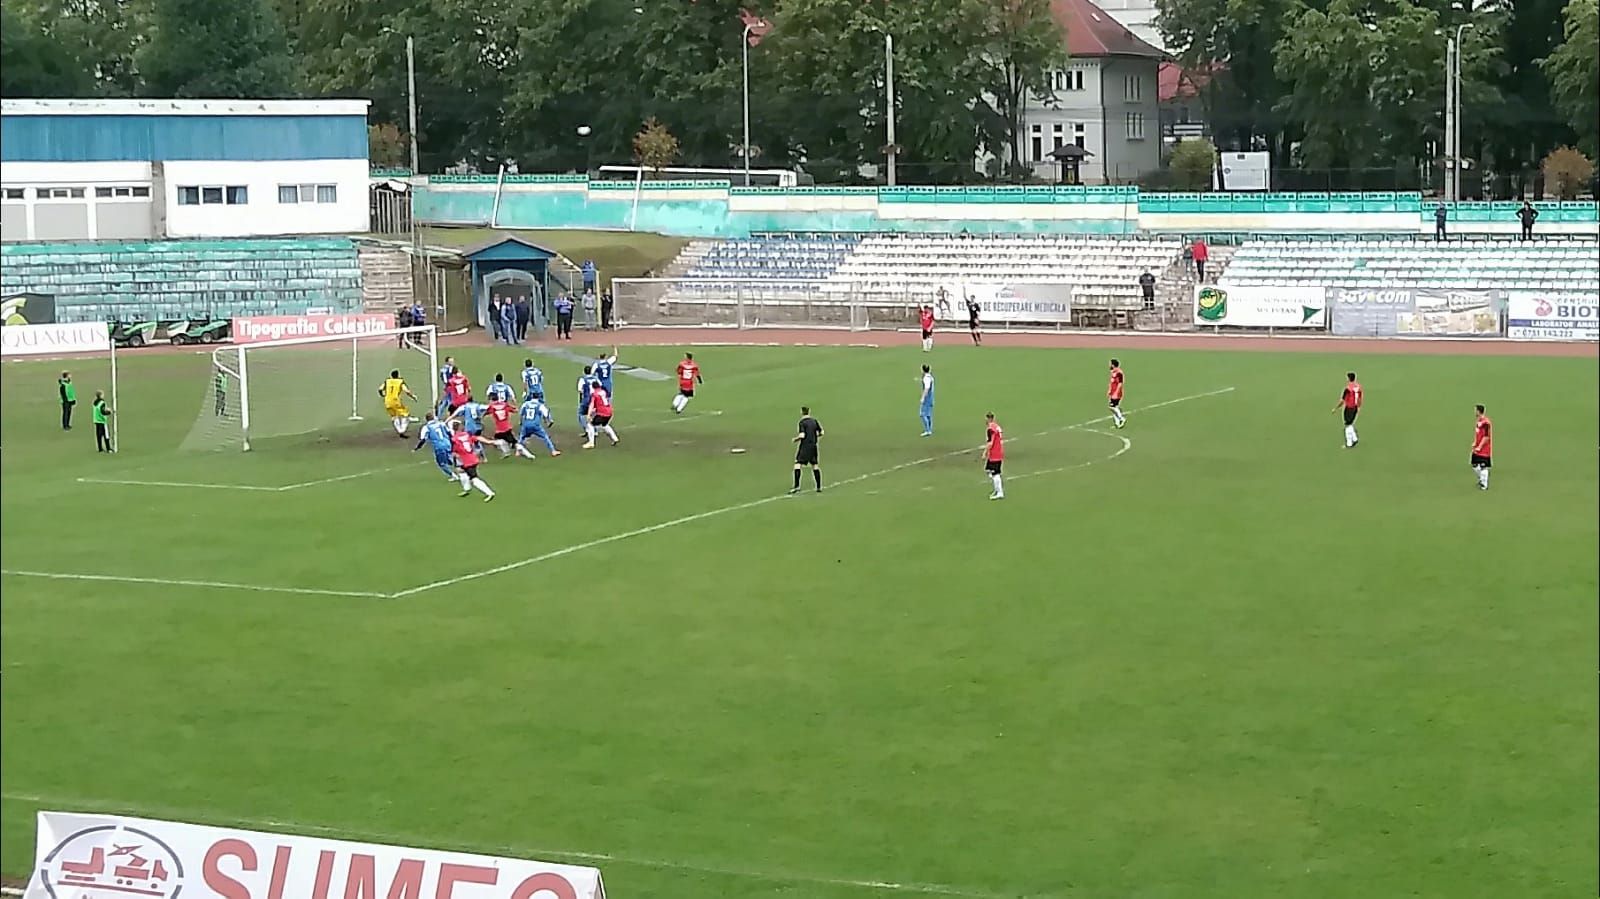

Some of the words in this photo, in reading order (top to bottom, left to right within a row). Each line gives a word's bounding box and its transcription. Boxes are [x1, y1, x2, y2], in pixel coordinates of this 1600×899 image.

[983, 301, 992, 312] DE
[993, 301, 1033, 313] RECUPERARE
[239, 319, 319, 340] Tipografia
[323, 317, 386, 335] Celestin
[1531, 320, 1574, 328] LABORATOR
